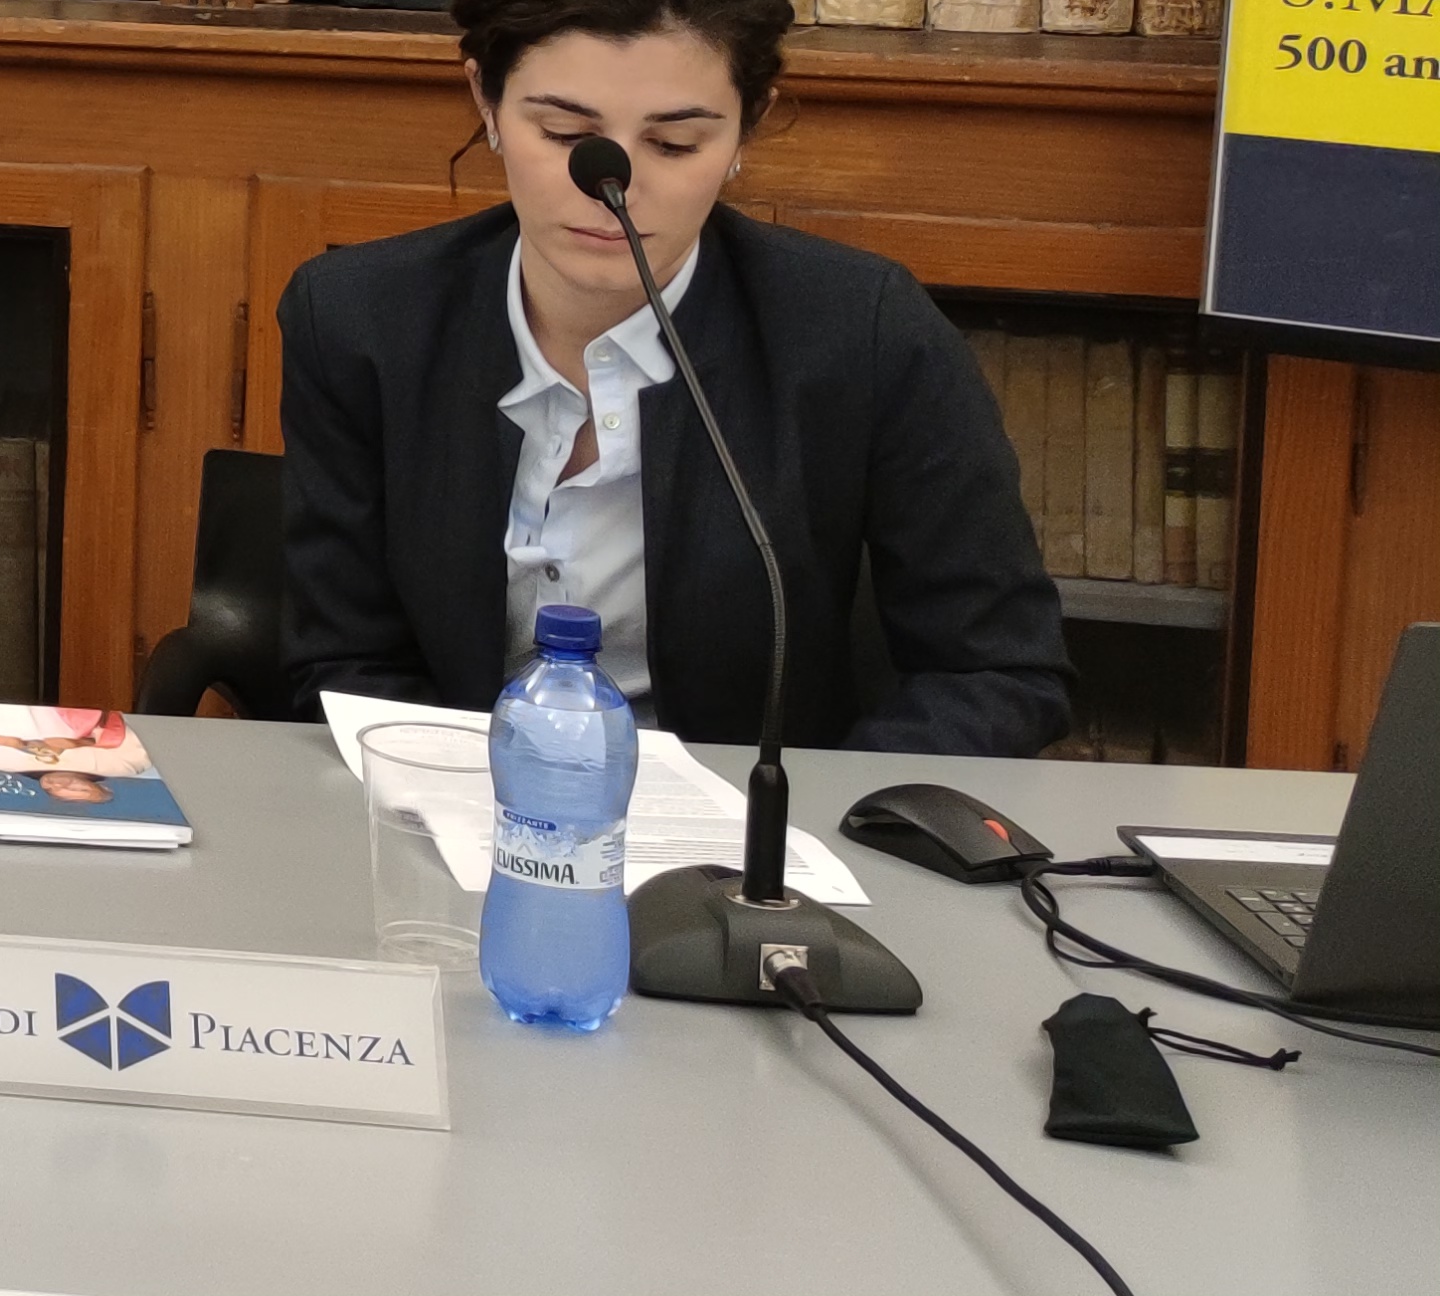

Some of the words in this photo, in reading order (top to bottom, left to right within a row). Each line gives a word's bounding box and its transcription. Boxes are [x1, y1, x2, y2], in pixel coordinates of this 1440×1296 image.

[1277, 34, 1367, 73] 500
[506, 812, 549, 830] FRIZZANTE
[190, 1013, 415, 1067] PIACENZA
